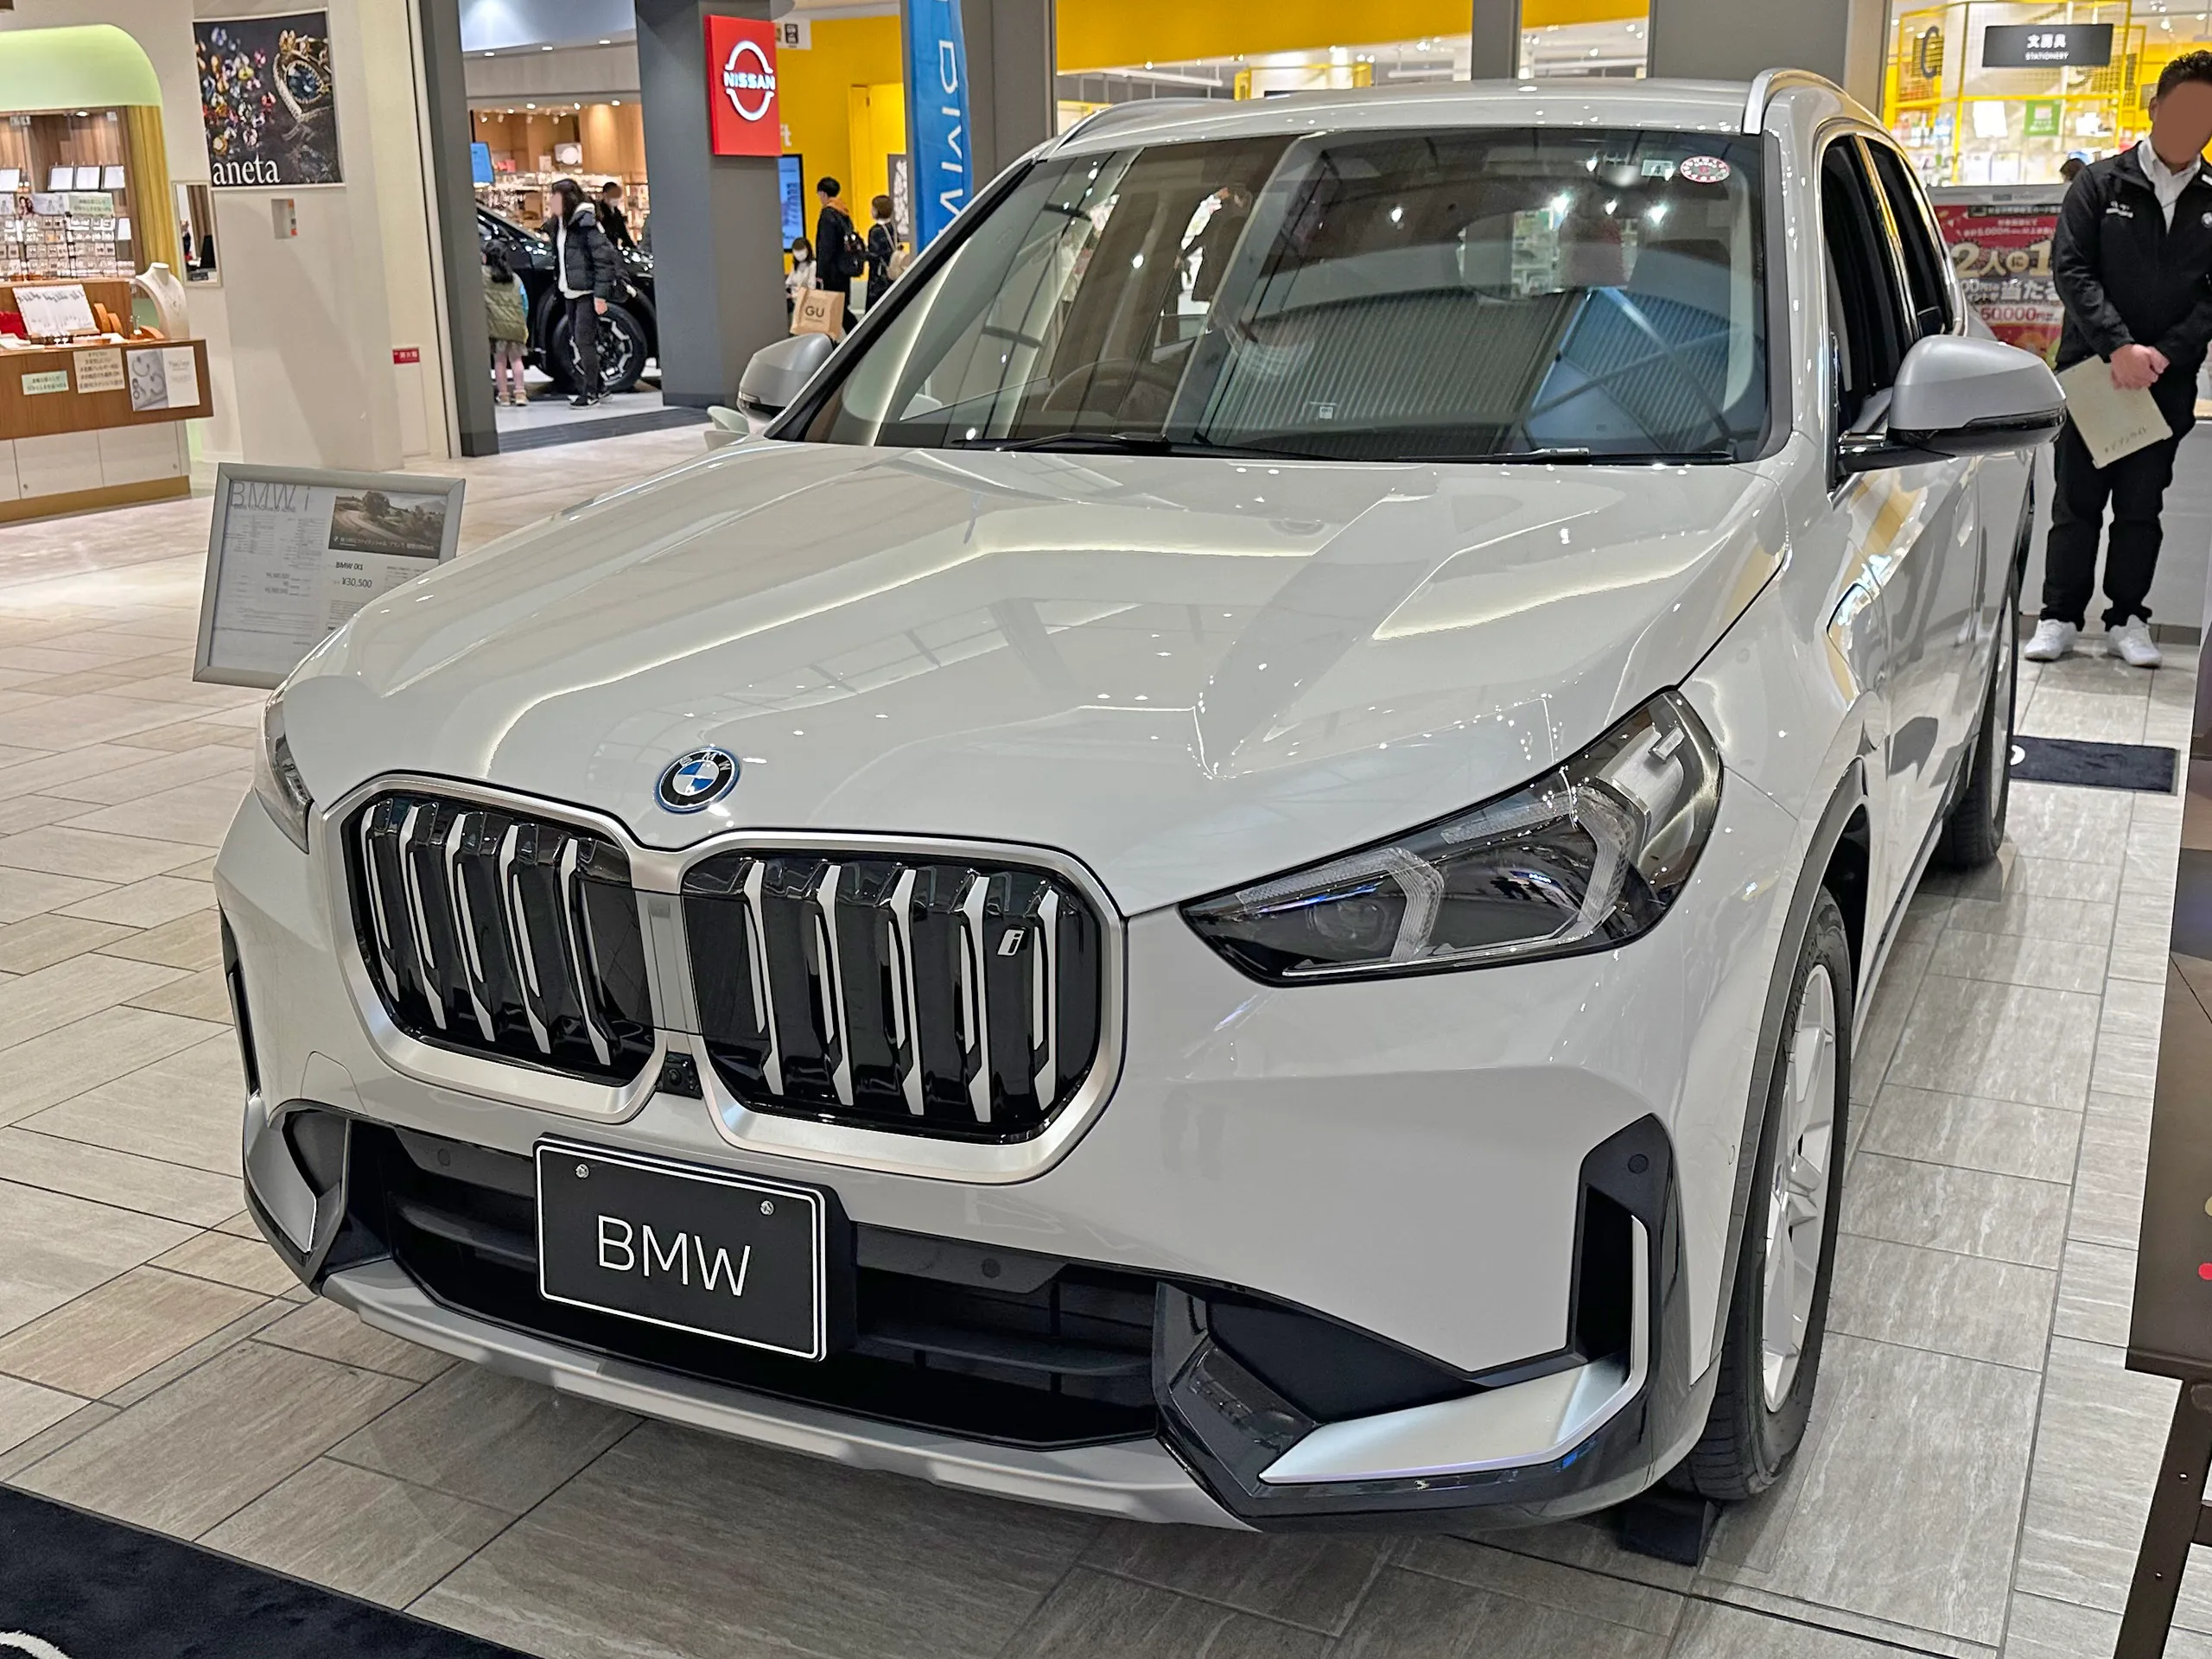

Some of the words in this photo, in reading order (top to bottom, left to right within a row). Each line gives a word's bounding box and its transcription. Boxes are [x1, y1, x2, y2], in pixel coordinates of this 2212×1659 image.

[2024, 52, 2069, 60] STATIONERY
[723, 70, 776, 91] NISSAN
[213, 151, 282, 186] aneta
[805, 305, 825, 318] GU
[231, 480, 297, 511] BMW
[341, 577, 373, 588] ¥30,500
[597, 1214, 752, 1297] BMW
